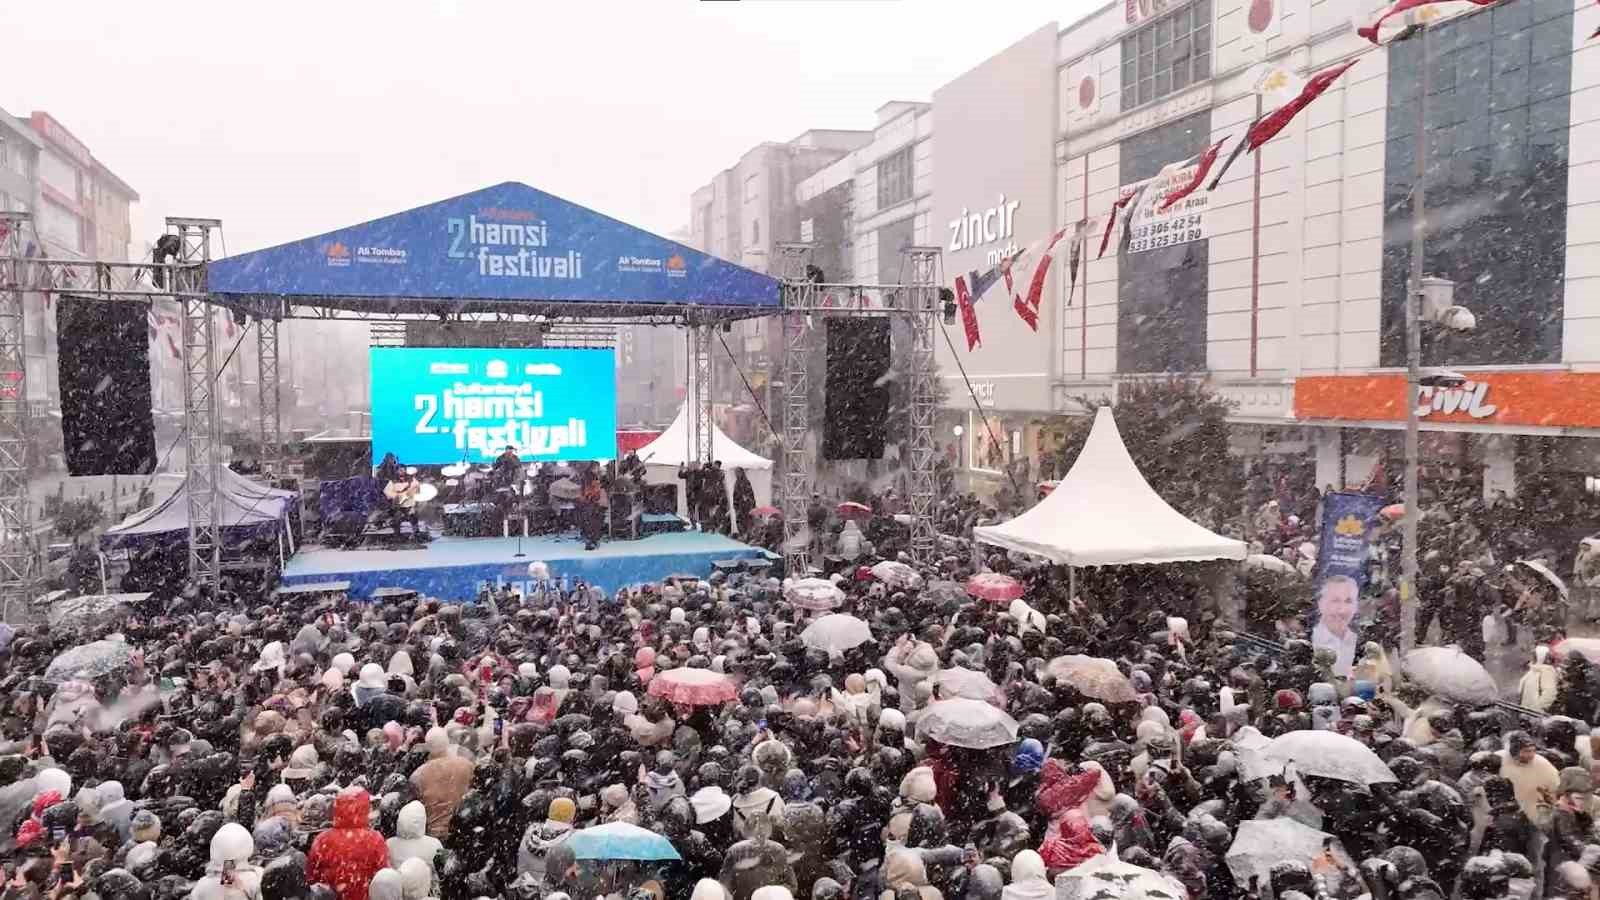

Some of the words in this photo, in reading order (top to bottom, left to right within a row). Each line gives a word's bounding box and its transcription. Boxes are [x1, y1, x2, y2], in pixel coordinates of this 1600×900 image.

[469, 214, 548, 247] hamsi
[949, 193, 1020, 252] zincir
[478, 246, 582, 279] festivali
[443, 388, 544, 420] hamsi
[452, 417, 587, 450] festivali
